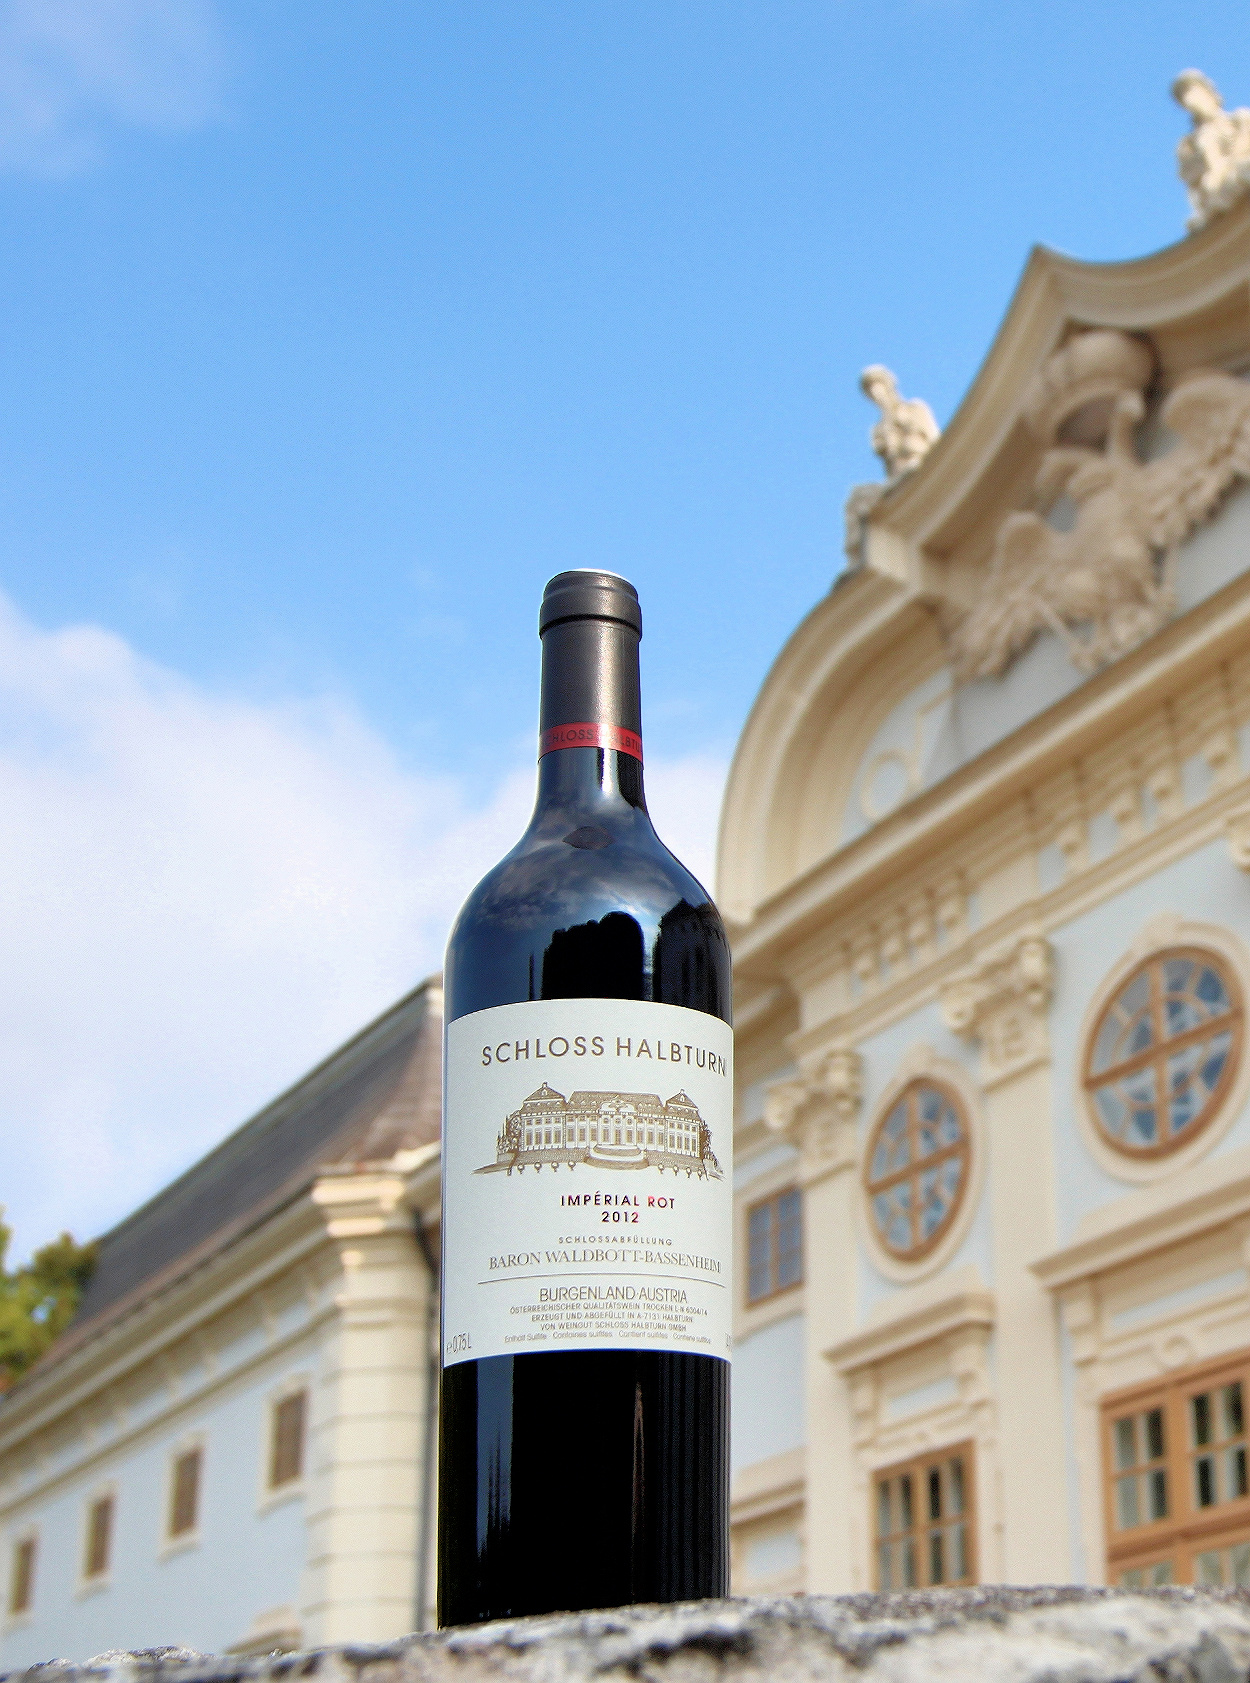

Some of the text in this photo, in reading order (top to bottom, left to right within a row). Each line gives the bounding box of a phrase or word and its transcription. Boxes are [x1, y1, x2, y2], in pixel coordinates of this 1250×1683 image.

[482, 1036, 726, 1077] SCHLOSS HALBTURN
[560, 1190, 675, 1209] IMPÉRIAL ROT
[601, 1211, 639, 1223] 2012
[558, 1235, 673, 1246] SCHLOSSABFÜLLUNG
[489, 1249, 721, 1273] BARON WALDBOTT-BASSENHEIM
[643, 1302, 673, 1312] TROCKEN
[531, 1312, 564, 1322] ERZEUGT
[566, 1312, 583, 1320] UND
[627, 1312, 635, 1320] IN
[540, 1322, 556, 1331] VON
[558, 1320, 593, 1330] WEINGUT
[594, 1320, 629, 1329] SCHLOSS
[630, 1320, 667, 1330] HALBTURN
